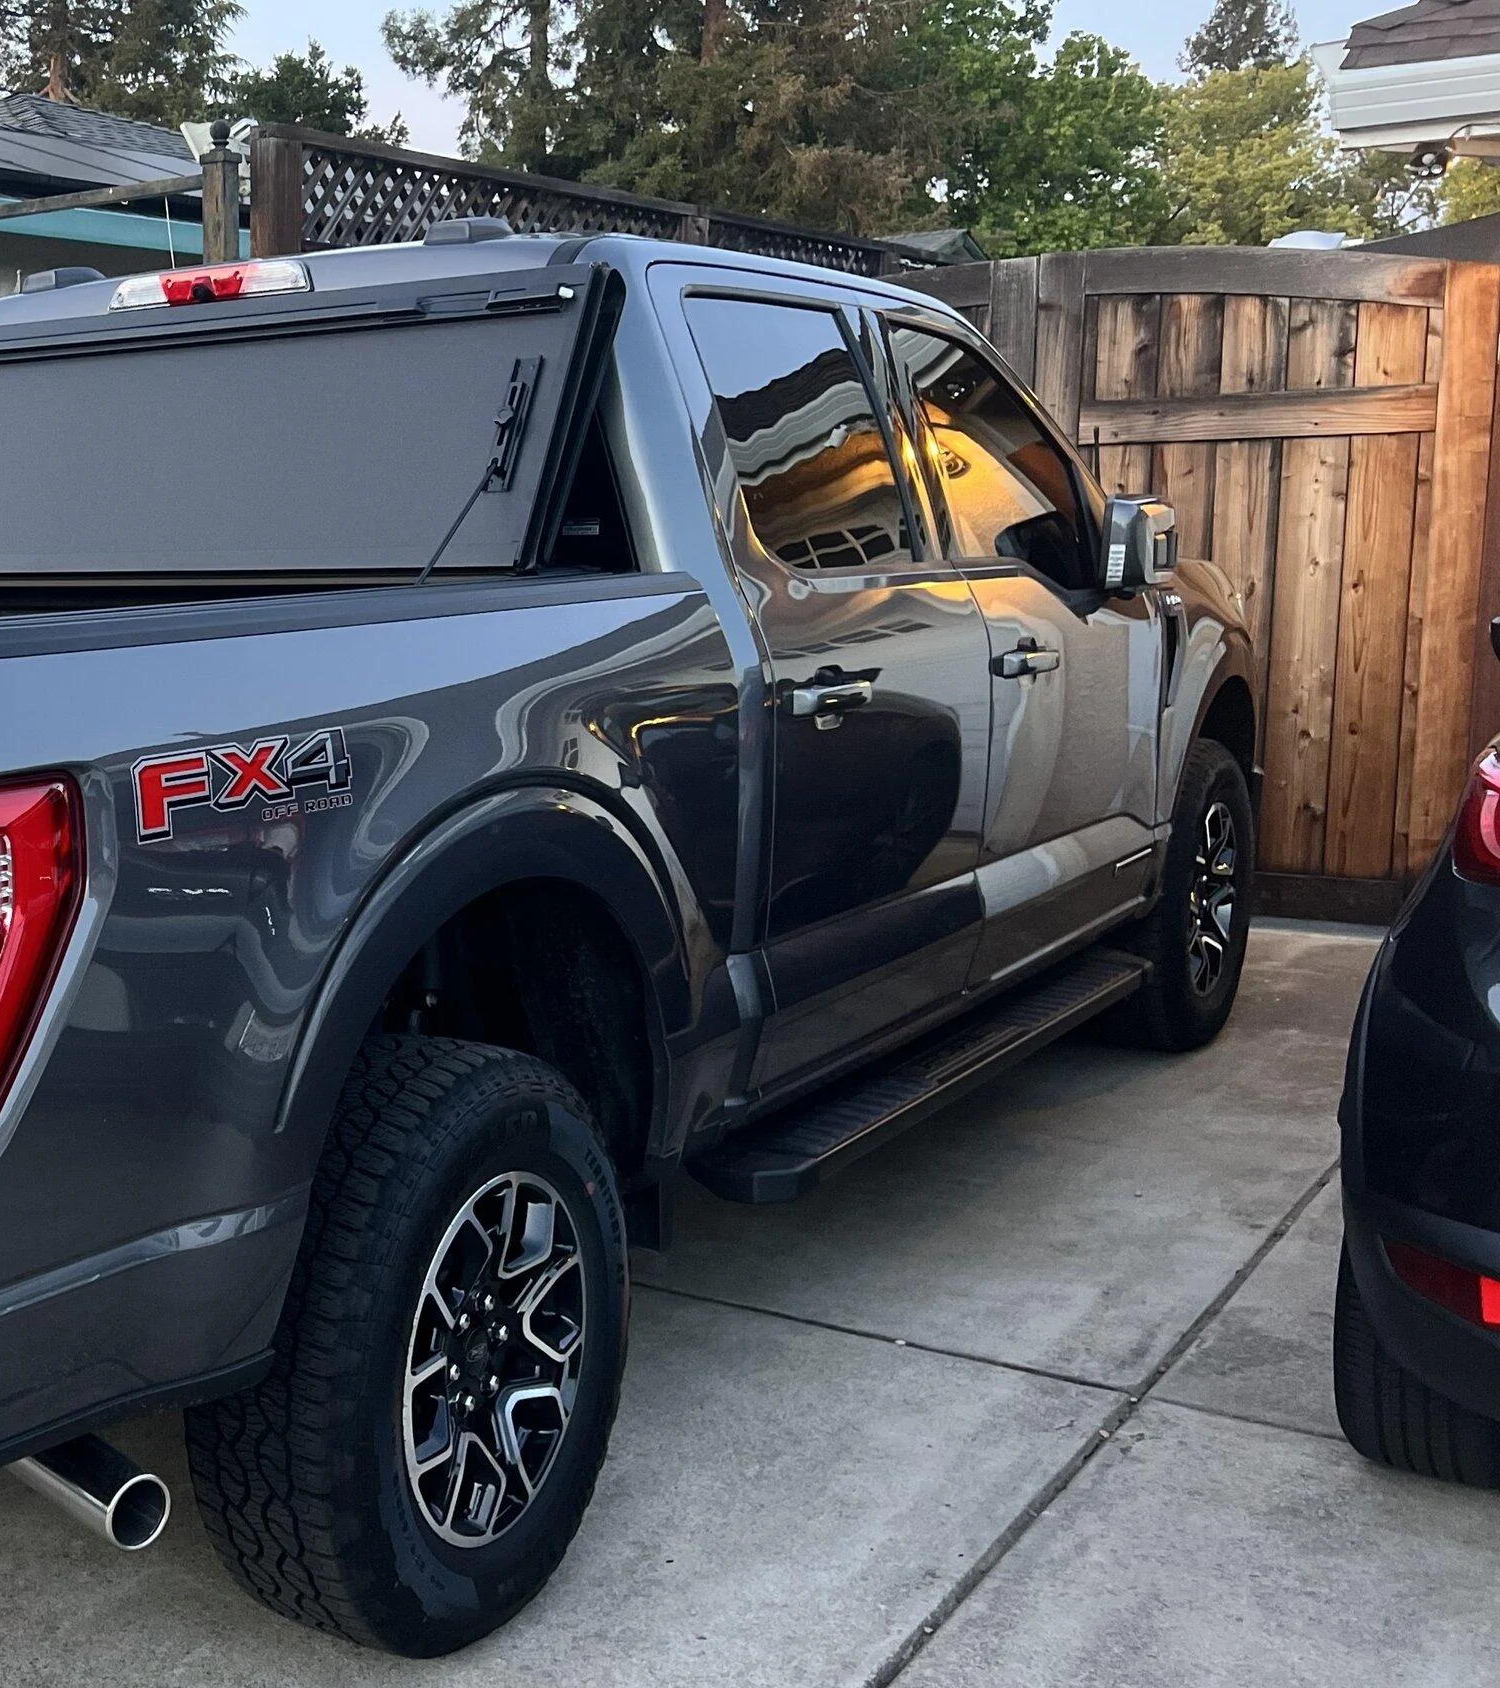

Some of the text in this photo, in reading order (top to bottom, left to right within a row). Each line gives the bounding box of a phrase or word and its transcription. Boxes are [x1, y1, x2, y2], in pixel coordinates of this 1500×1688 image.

[130, 726, 353, 845] FX4
[262, 794, 353, 822] OFF ROAD
